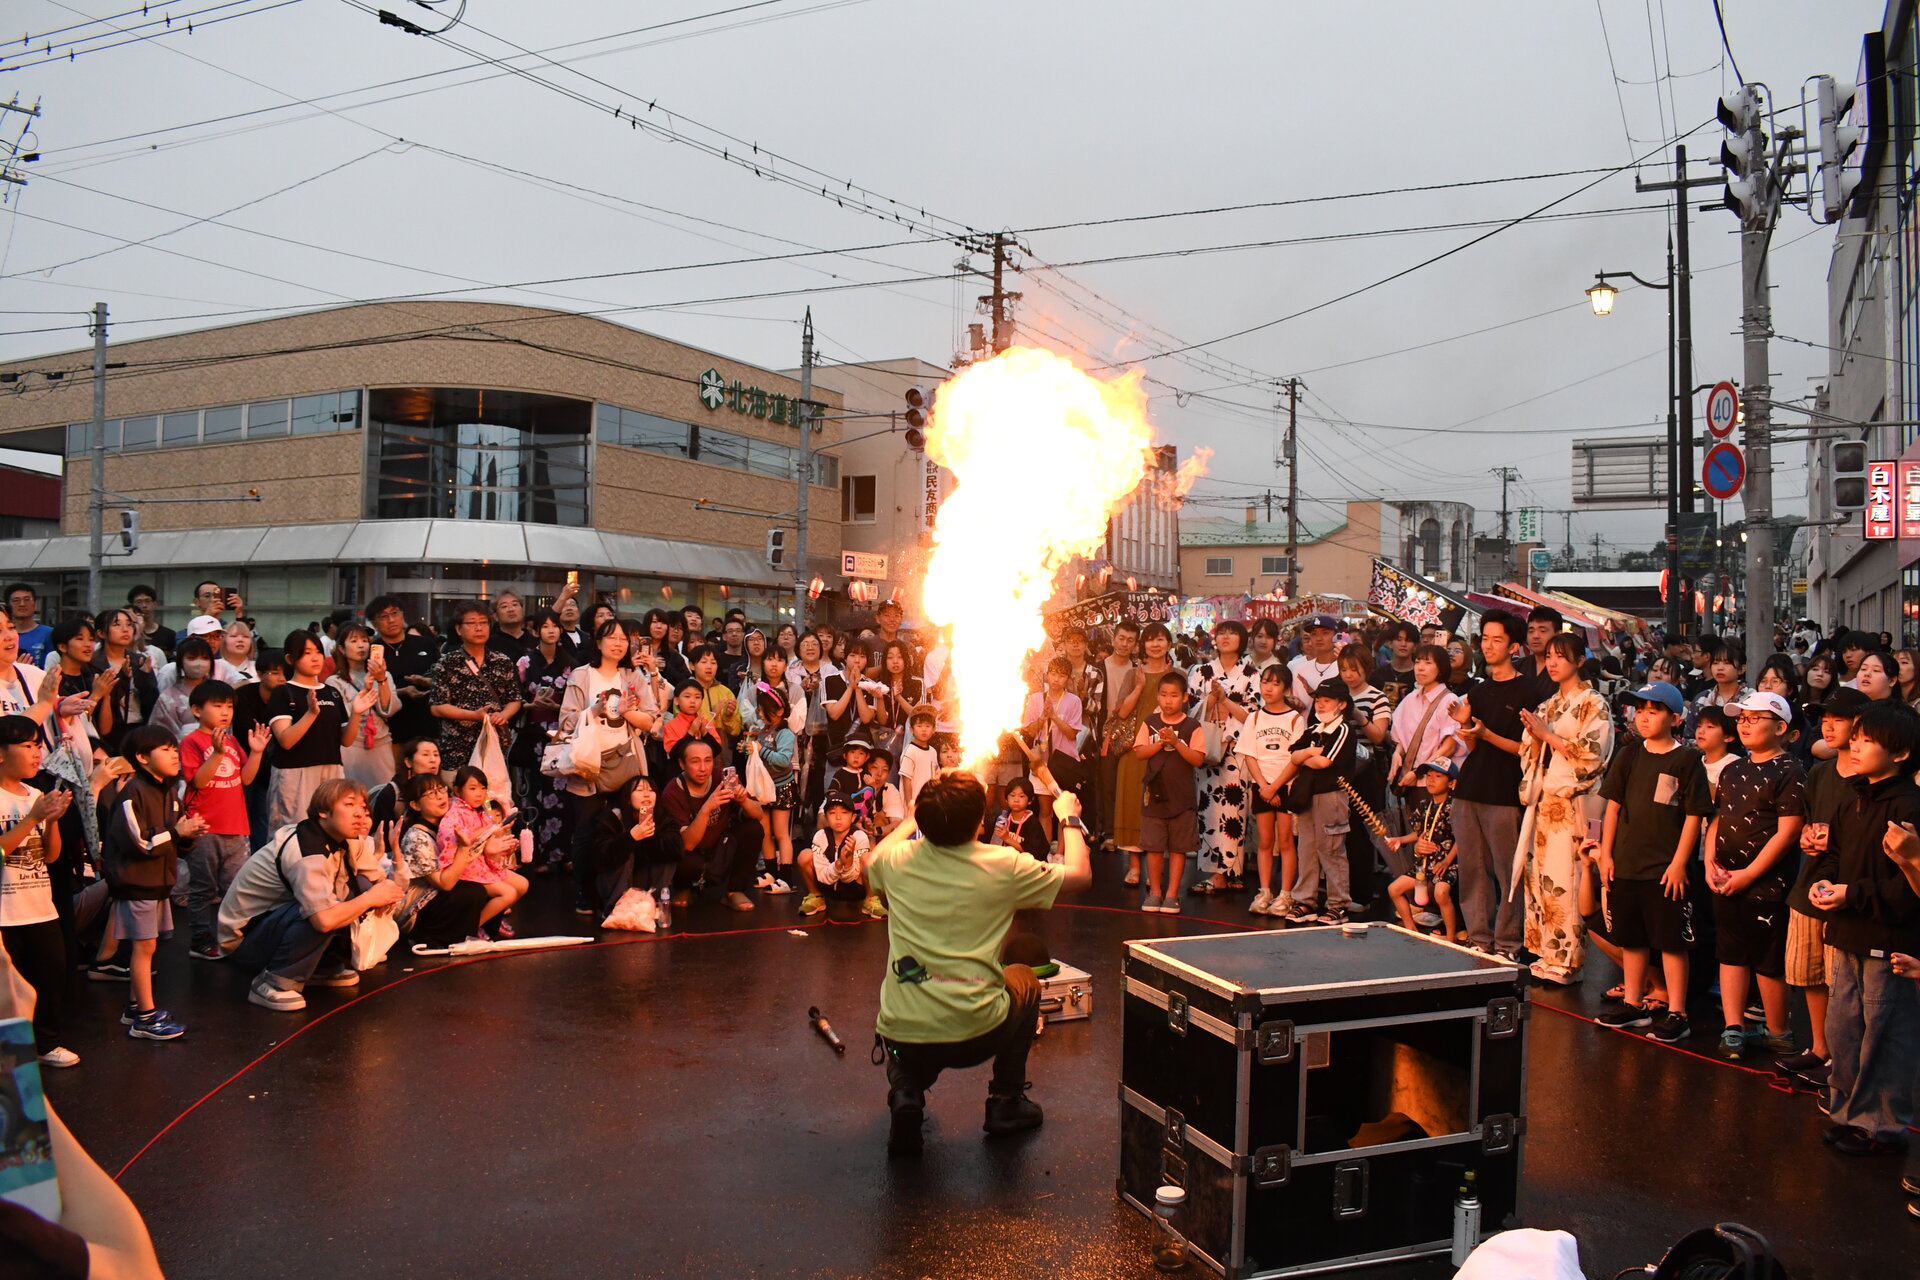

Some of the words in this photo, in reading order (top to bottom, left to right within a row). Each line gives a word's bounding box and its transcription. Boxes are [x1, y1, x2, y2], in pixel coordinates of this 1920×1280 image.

[1713, 397, 1731, 423] 40
[1870, 466, 1892, 522] 白木屋
[1873, 526, 1889, 536] 1F
[1256, 727, 1292, 741] CONSCIENCE
